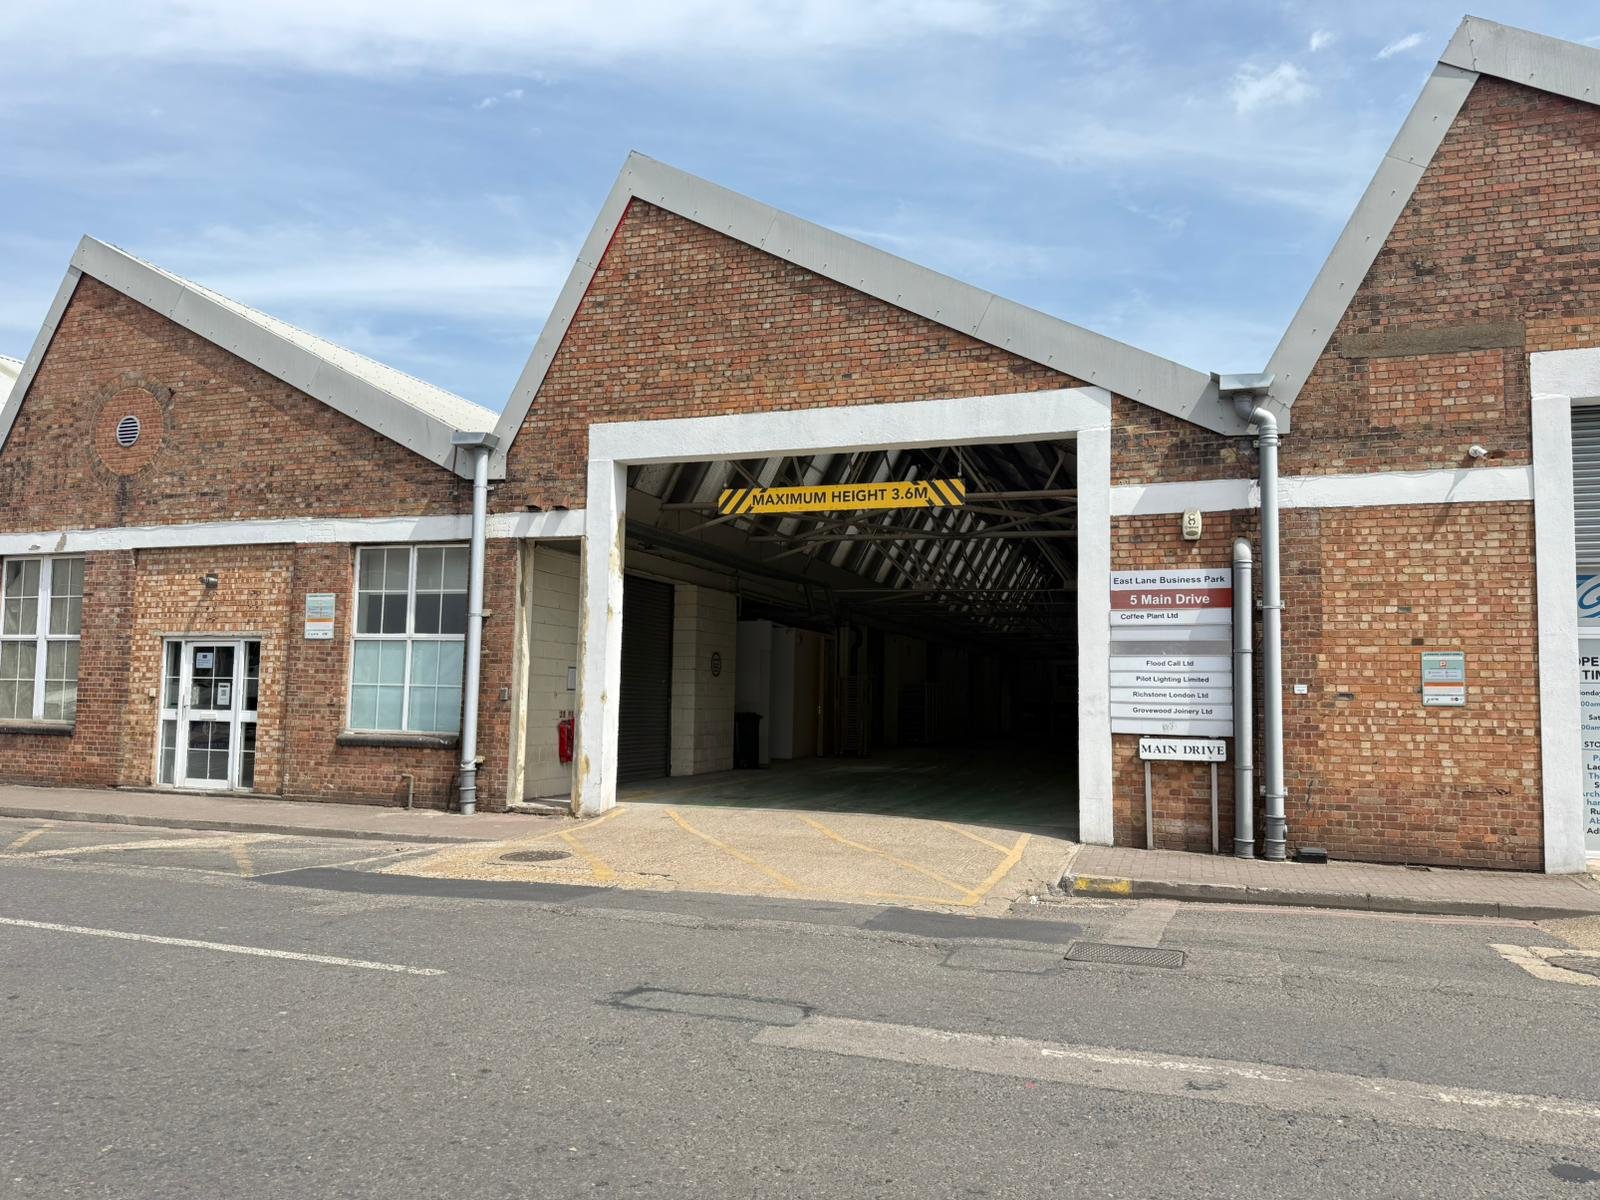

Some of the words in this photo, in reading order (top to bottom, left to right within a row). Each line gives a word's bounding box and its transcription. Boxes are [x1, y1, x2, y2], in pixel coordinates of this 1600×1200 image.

[752, 492, 827, 507] MAXIMUM
[831, 488, 887, 503] HEIGHT
[891, 486, 928, 501] 3.6M
[1113, 577, 1133, 585] East
[1135, 577, 1157, 585] Lane
[1159, 576, 1202, 584] Business
[1204, 575, 1225, 583] Park
[1130, 595, 1138, 605] 5
[1141, 594, 1172, 605] Main
[1175, 593, 1210, 604] Drive
[1579, 656, 1600, 667] PE
[1153, 676, 1182, 684] Lighting
[1173, 708, 1200, 716] Joinery
[1141, 744, 1178, 755] MAIN
[1183, 745, 1225, 756] DRIVE
